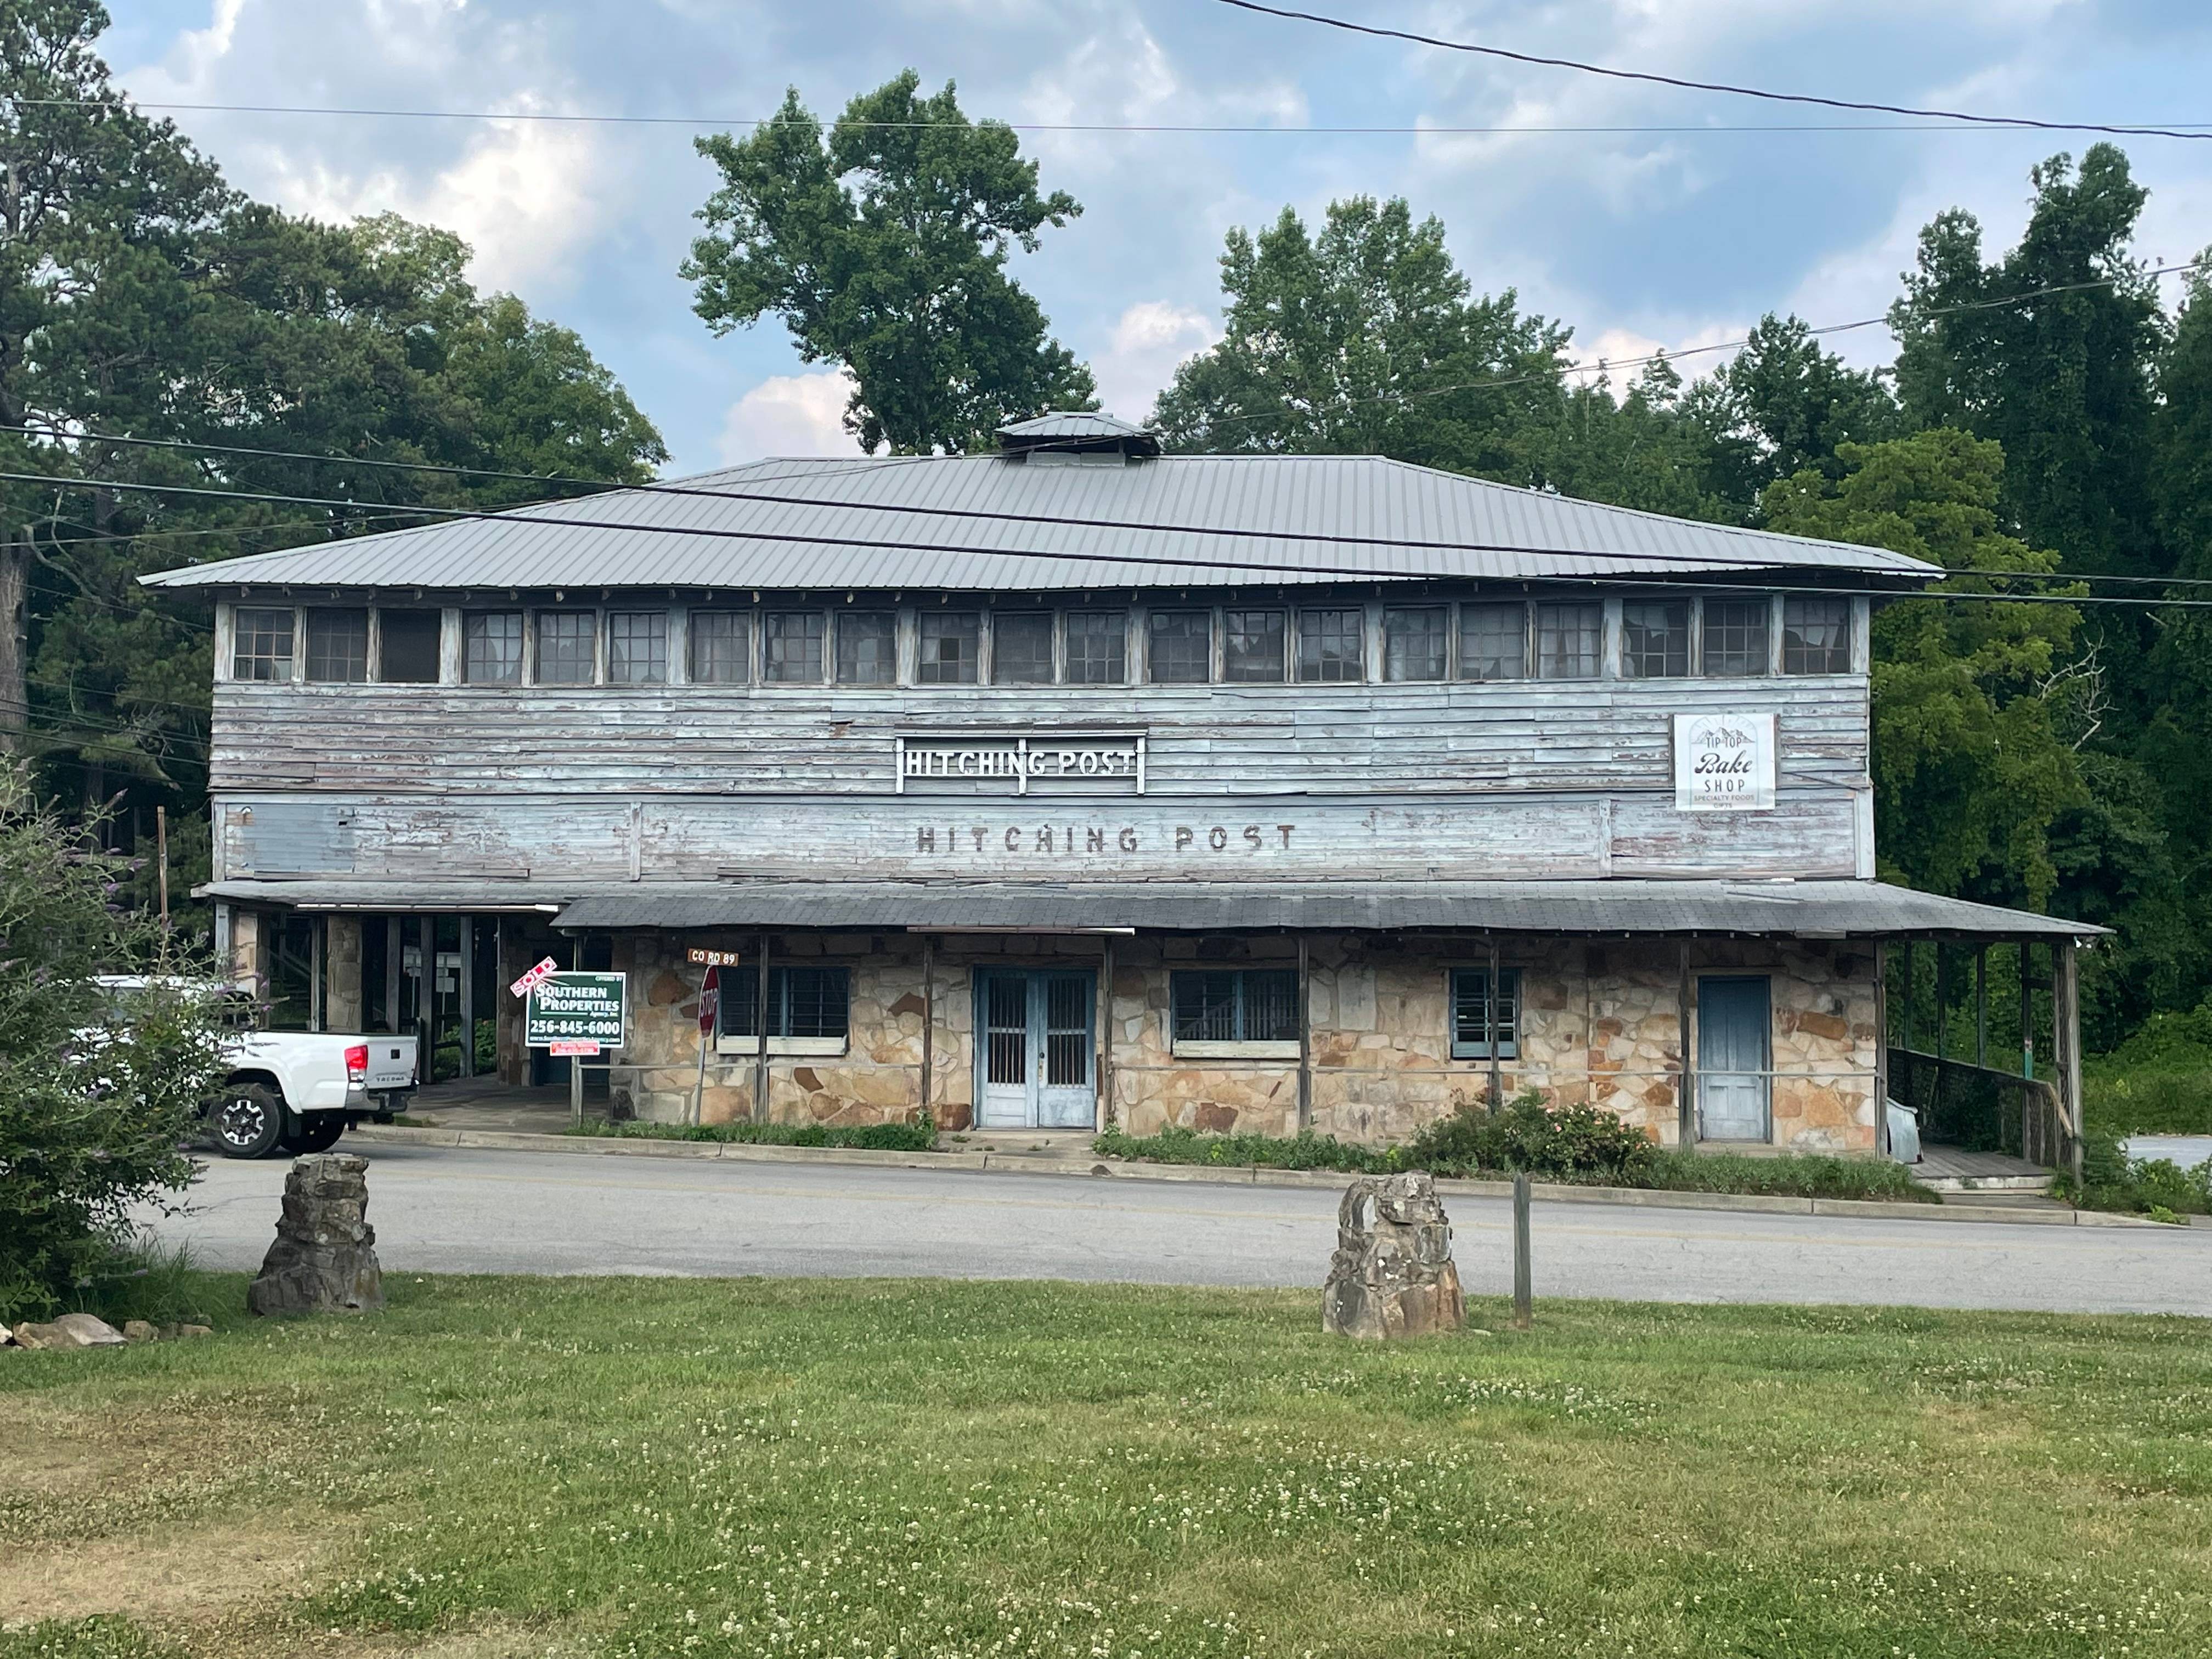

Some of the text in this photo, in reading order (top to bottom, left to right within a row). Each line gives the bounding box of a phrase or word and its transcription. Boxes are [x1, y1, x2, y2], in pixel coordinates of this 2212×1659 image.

[1707, 737, 1742, 748] TIP TOP
[906, 752, 1136, 775] HITCHING POST
[1694, 749, 1753, 774] Bake
[1705, 779, 1745, 793] SHOP
[917, 825, 1295, 853] HITCHING POST
[692, 950, 735, 964] CO RD 89
[514, 960, 553, 994] SOLD
[536, 984, 607, 998] SOUTHERN
[540, 997, 619, 1011] PROPERTIES
[701, 988, 719, 1017] STOP
[530, 1019, 620, 1035] 256-845-6000
